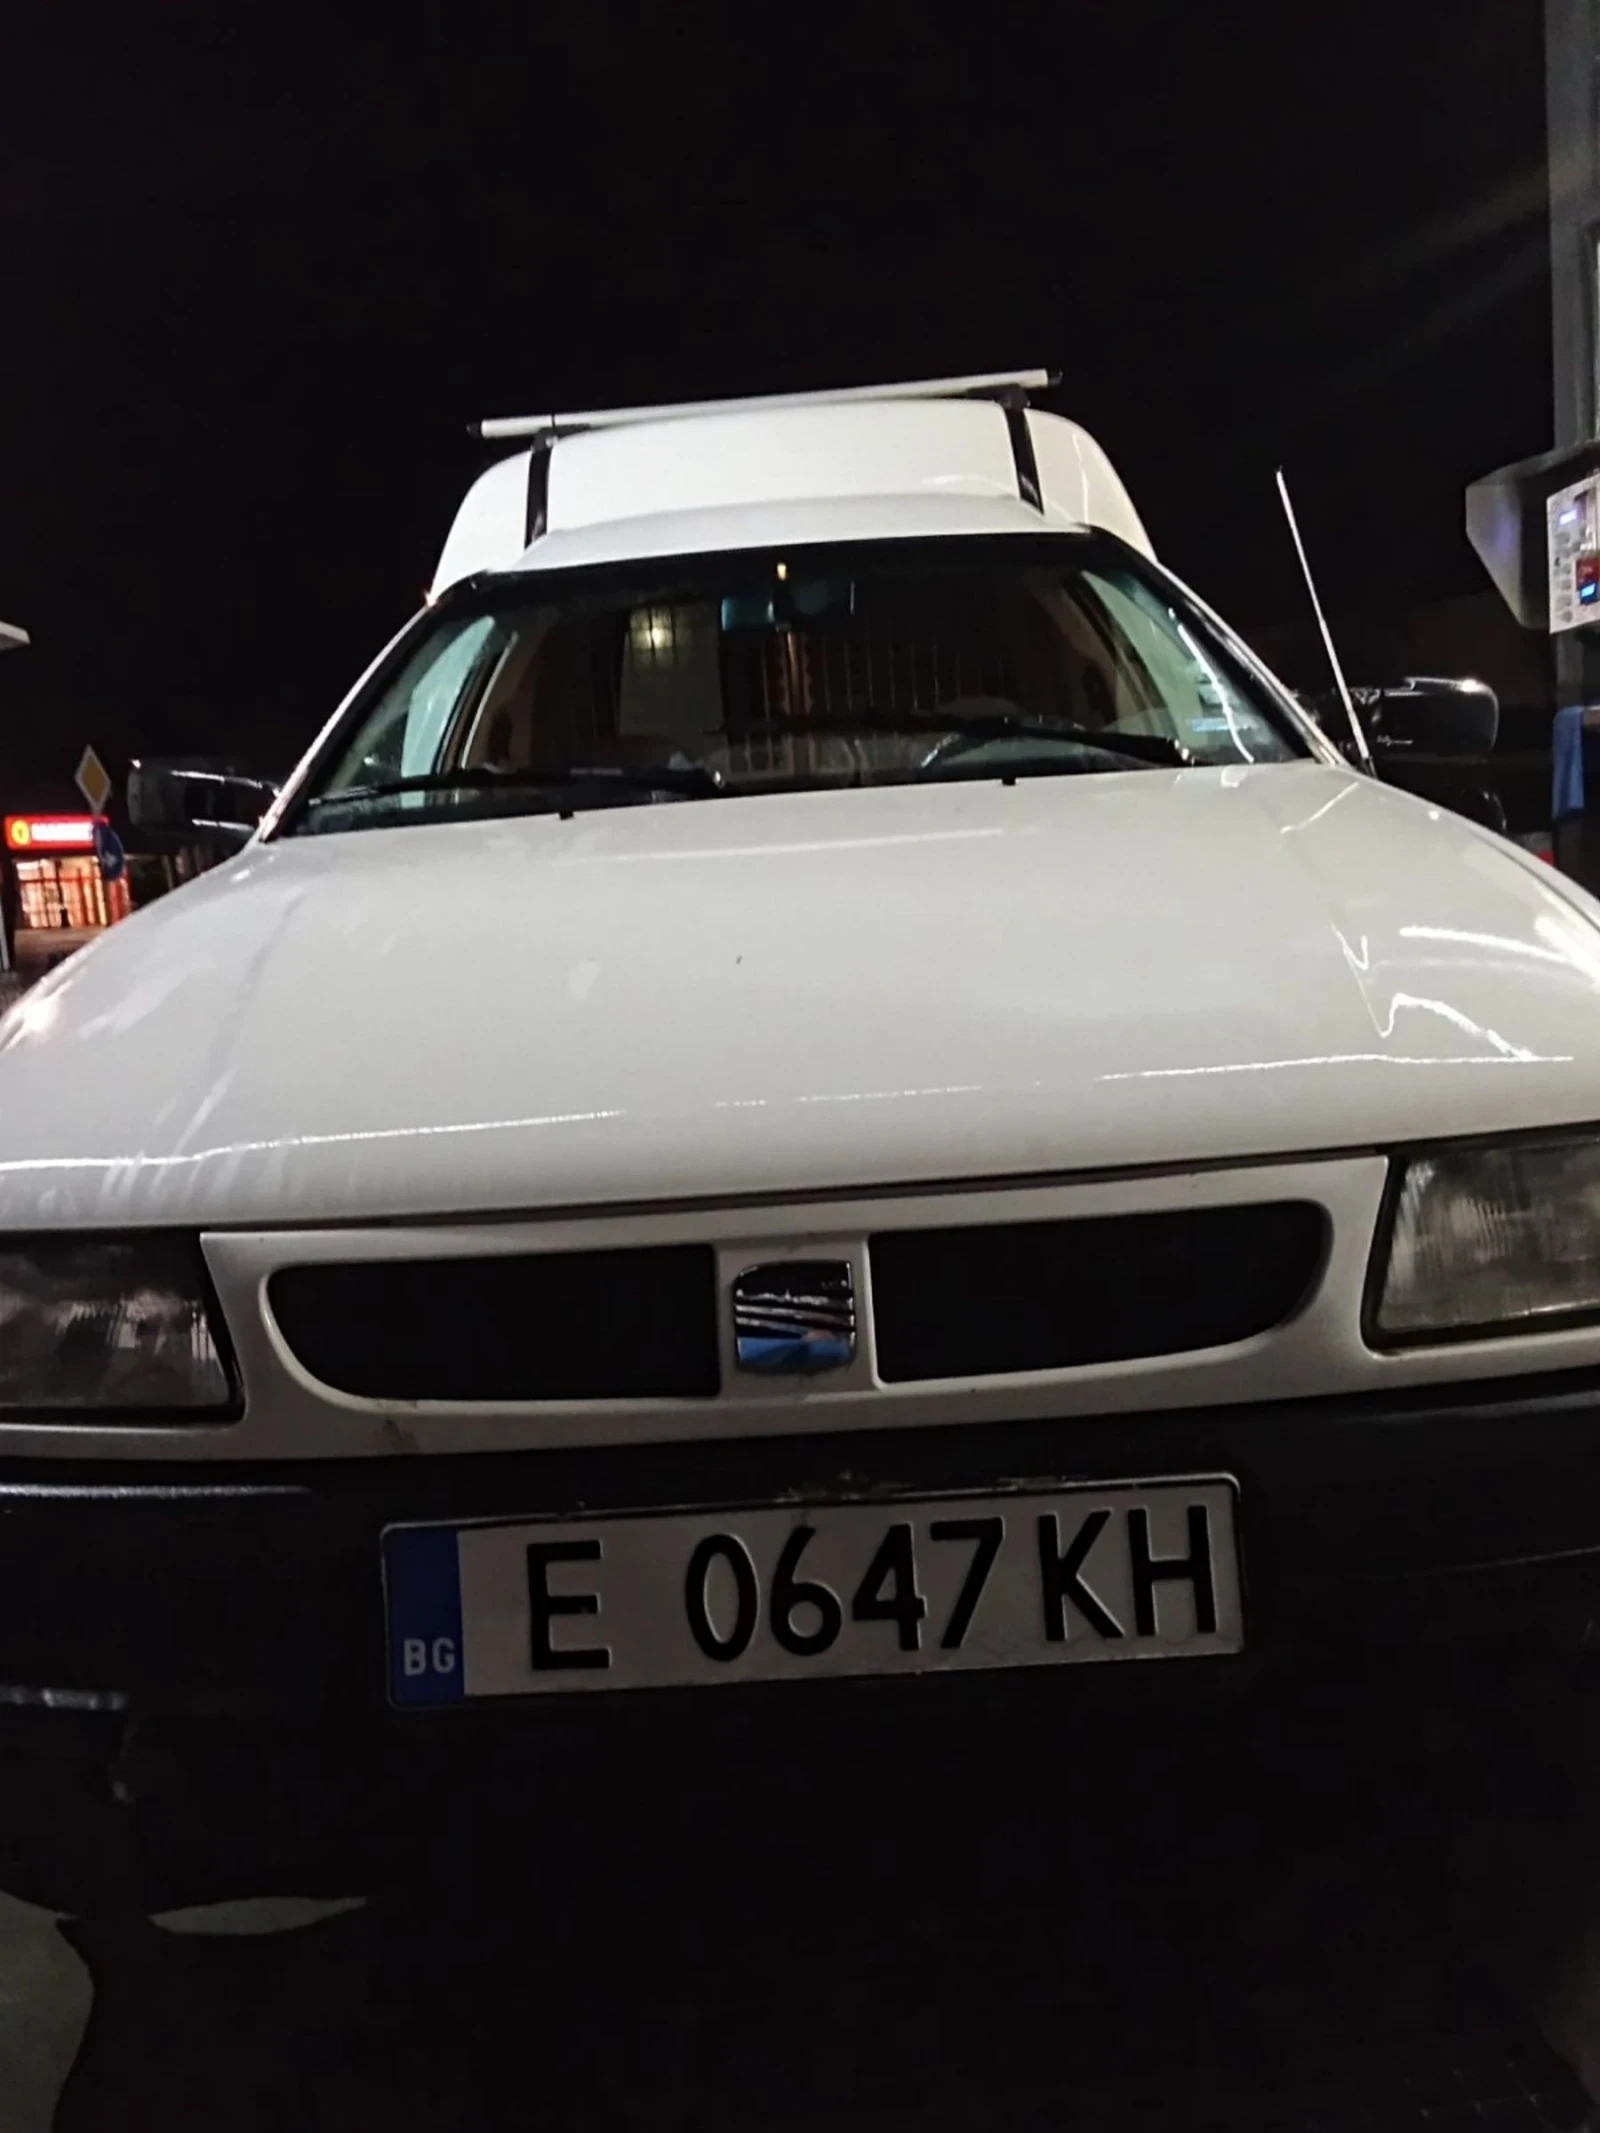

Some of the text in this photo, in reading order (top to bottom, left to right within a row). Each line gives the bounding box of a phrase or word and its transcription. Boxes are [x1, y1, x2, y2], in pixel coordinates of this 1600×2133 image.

[526, 1505, 1216, 1671] E 0647 KH
[404, 1638, 455, 1676] BG
